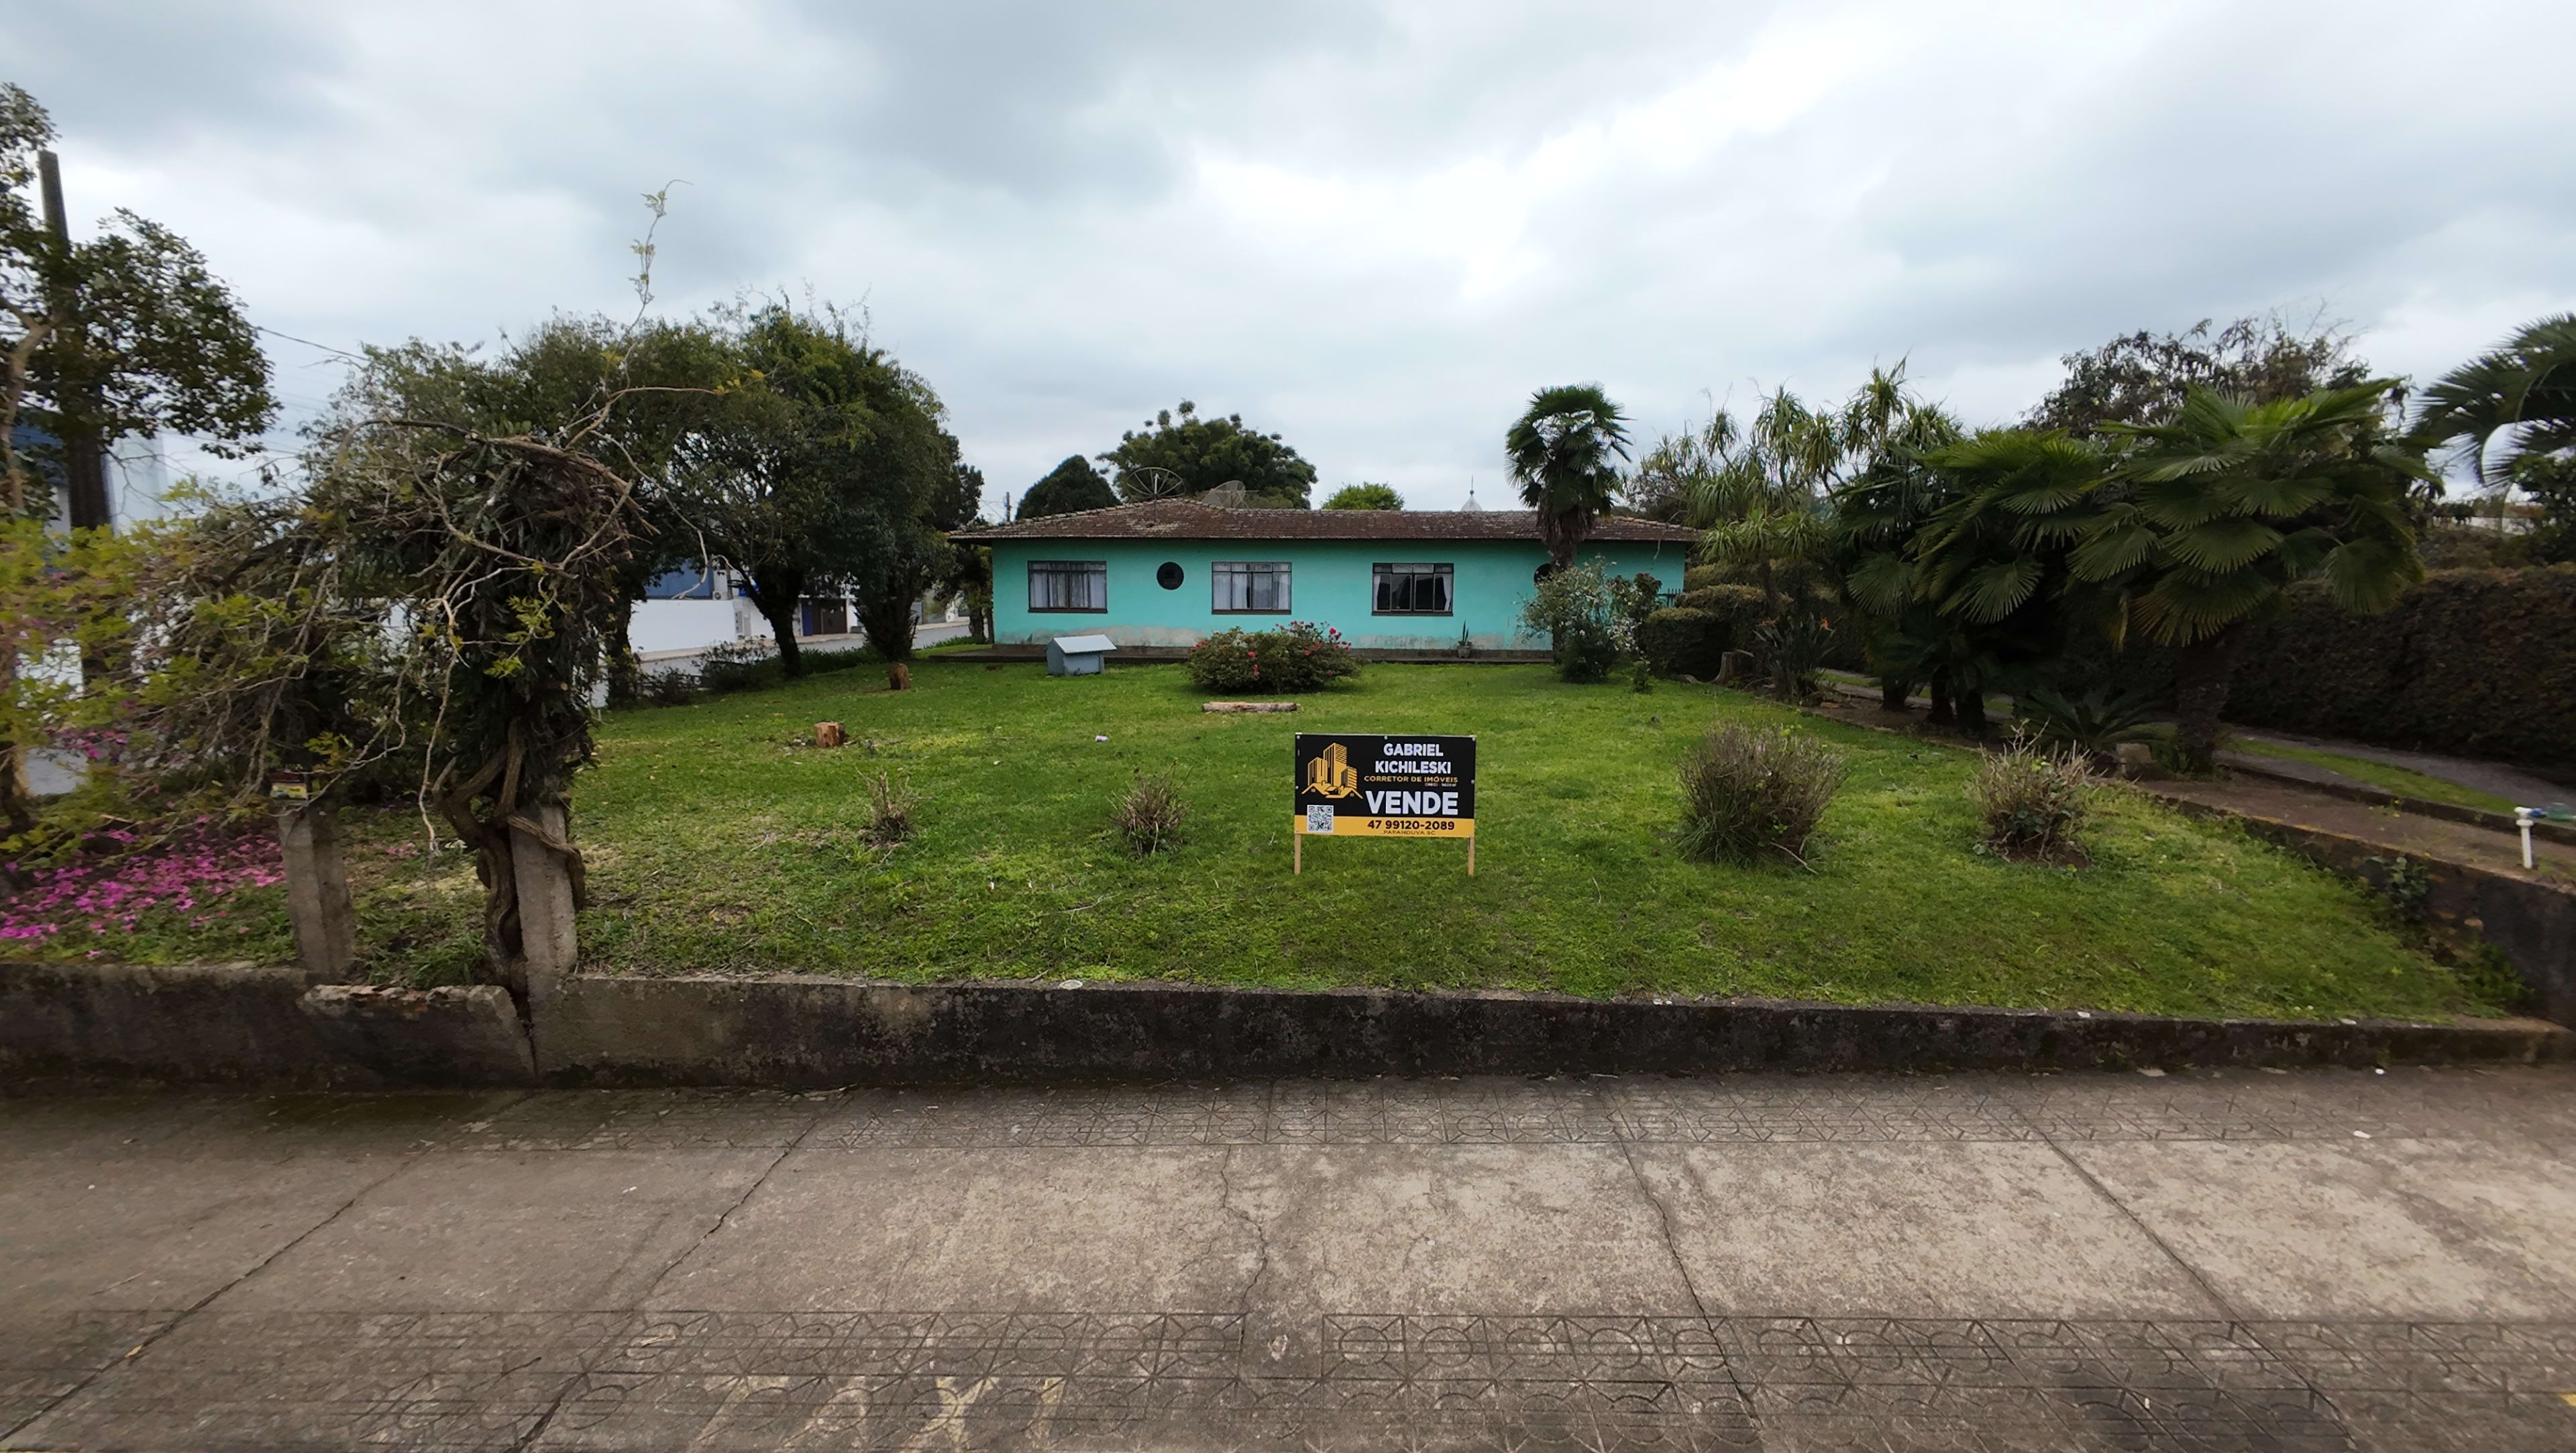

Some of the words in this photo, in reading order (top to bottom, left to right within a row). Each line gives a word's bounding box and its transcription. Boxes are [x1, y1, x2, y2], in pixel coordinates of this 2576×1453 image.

[1383, 743, 1444, 757] GABRIEL
[1375, 761, 1451, 774] KICHILESKI
[1424, 775, 1458, 784] IMÓVEIS
[1365, 790, 1458, 816] VENDE
[1367, 820, 1382, 829] 47
[1385, 820, 1454, 830] 99120-2089
